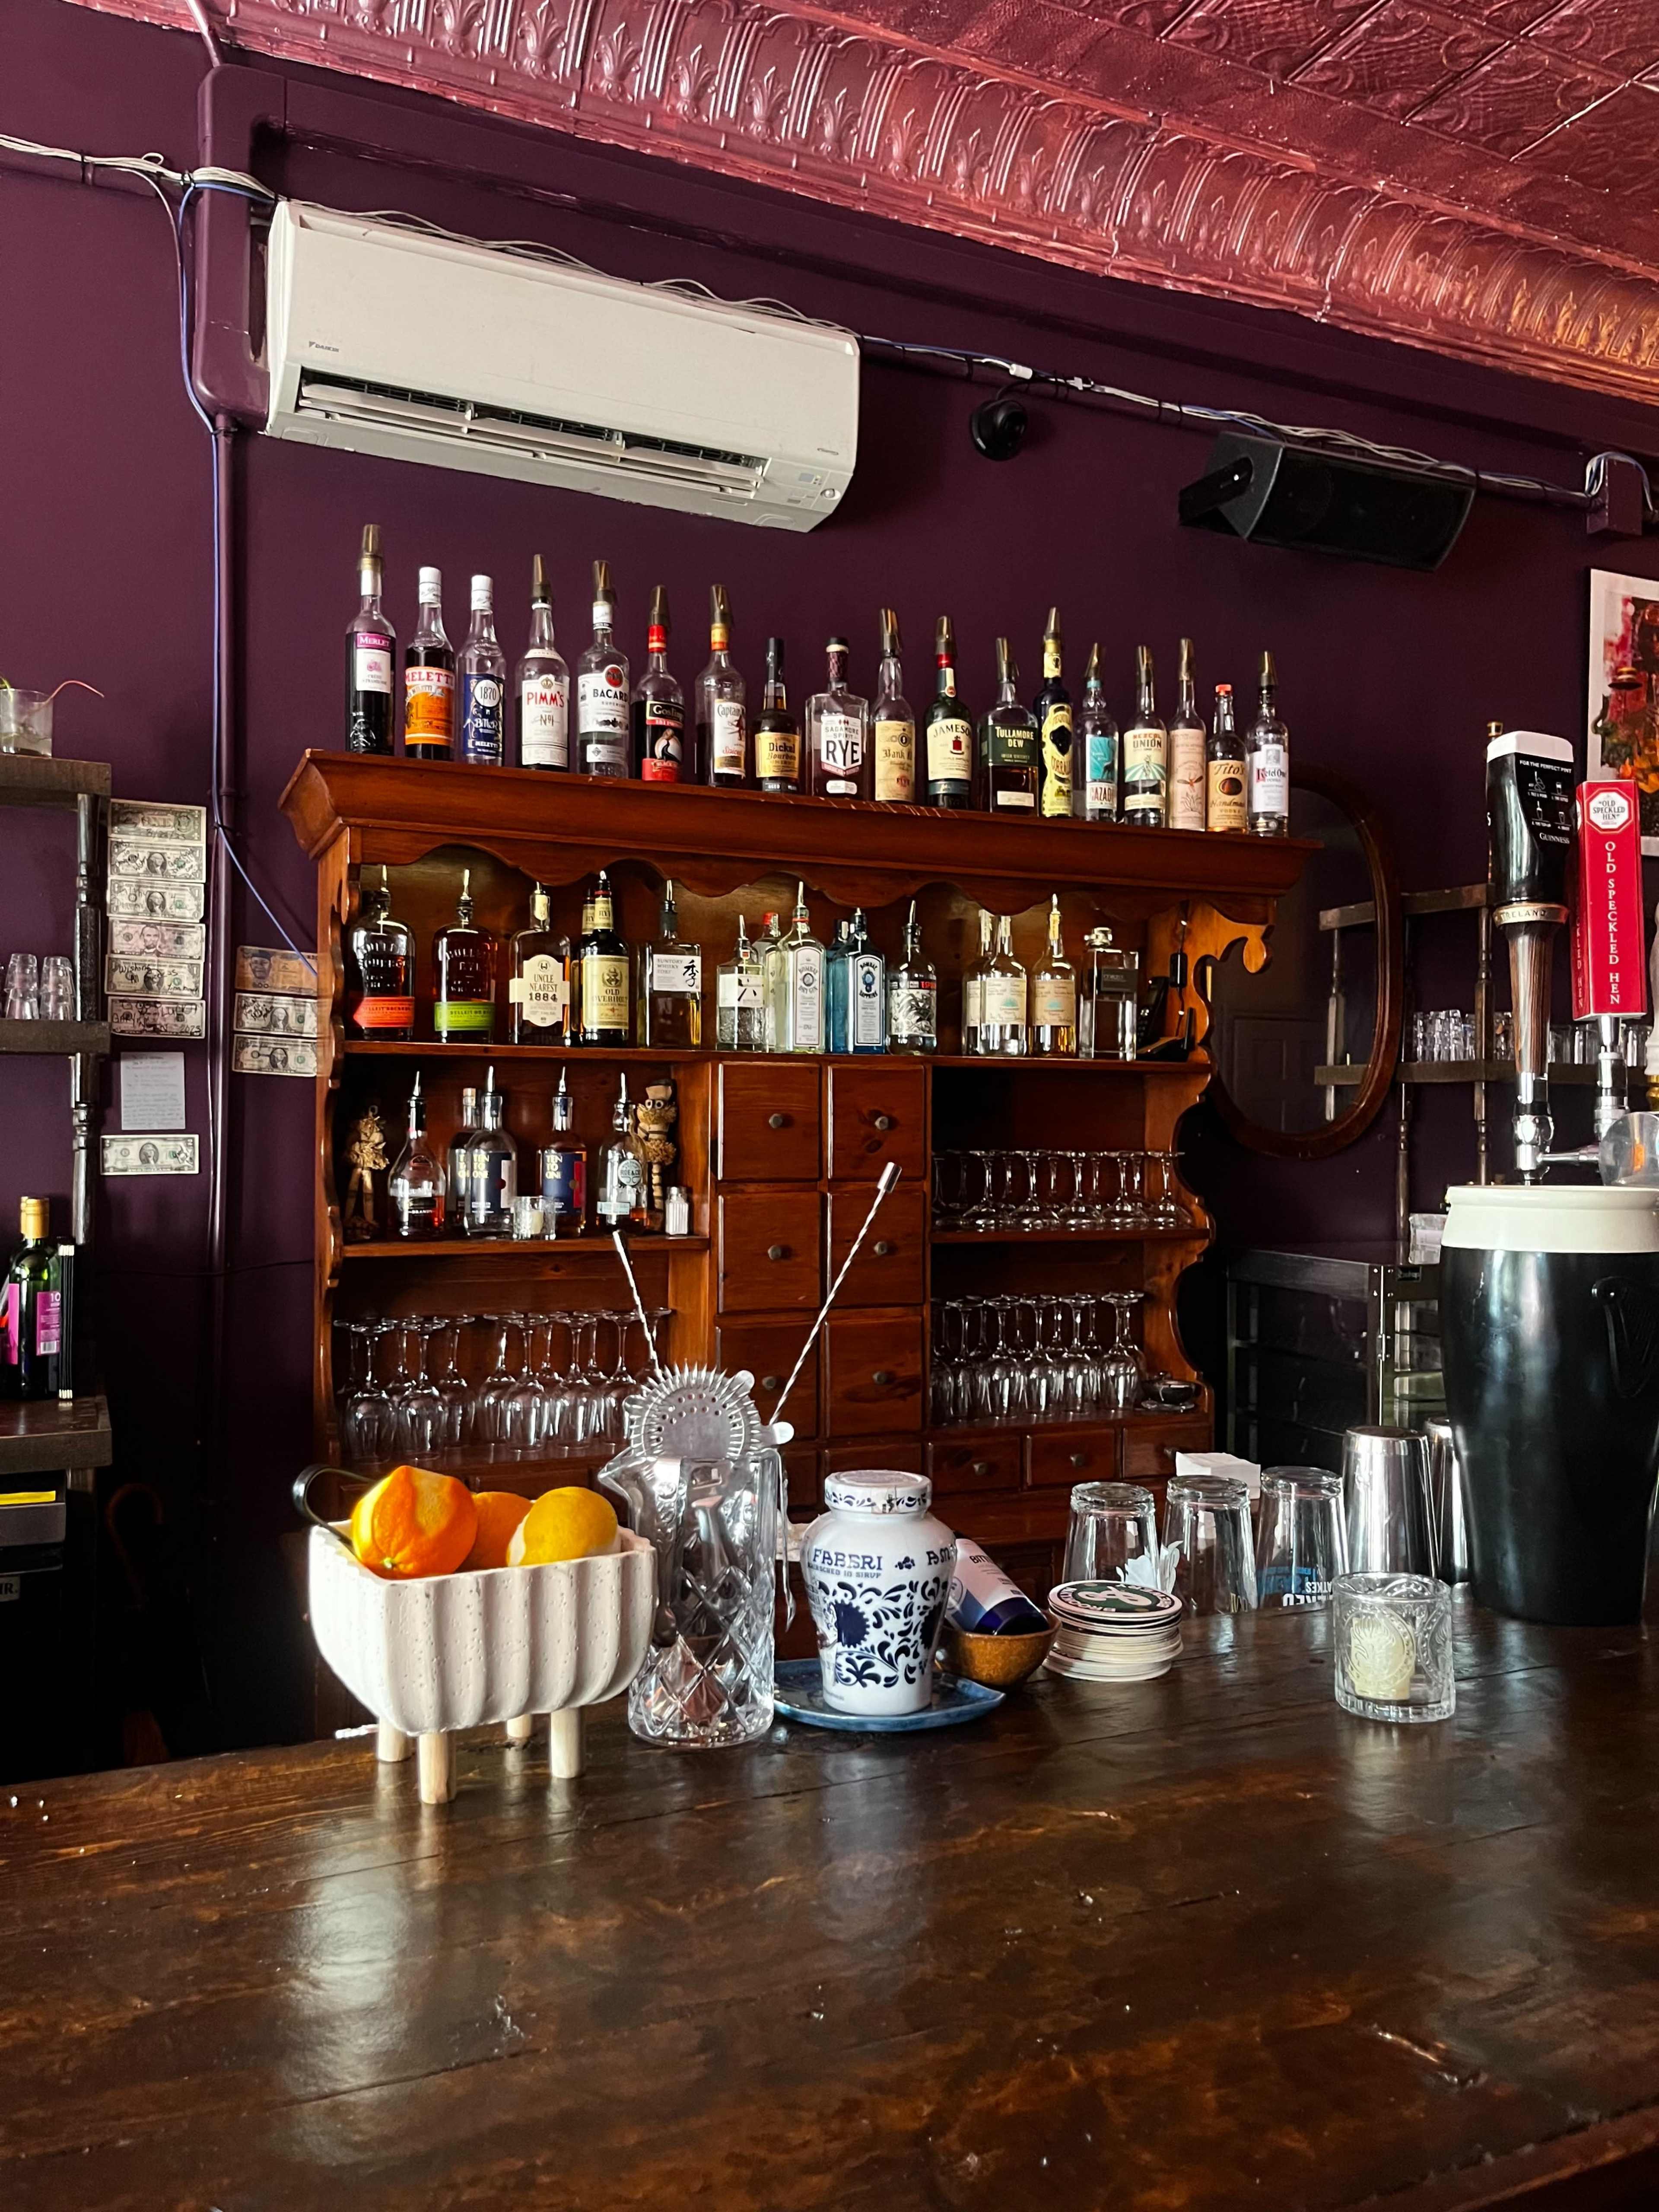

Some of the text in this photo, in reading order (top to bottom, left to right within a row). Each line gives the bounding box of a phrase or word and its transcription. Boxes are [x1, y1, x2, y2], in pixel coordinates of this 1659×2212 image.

[359, 636, 390, 647] MERLET
[480, 686, 497, 701] 1870
[526, 691, 565, 708] PIMM'S
[593, 689, 629, 702] BACARD
[717, 704, 743, 718] Captain
[825, 726, 859, 735] SAGAMORE
[933, 724, 971, 738] JAMESO
[995, 726, 1034, 740] TULLAMORE
[1008, 739, 1024, 747] DEW
[826, 740, 859, 767] RYE
[1214, 763, 1245, 776] Tito's
[1540, 763, 1560, 772] PERFECT
[1539, 832, 1570, 844] GUINNESS
[1605, 841, 1621, 1005] OLD SPECKLED HEN
[534, 974, 554, 984] UNCLE
[529, 983, 558, 993] NEAREST
[529, 993, 558, 1003] 1884
[592, 995, 628, 1004] VERHO
[545, 1154, 563, 1163] TEN
[546, 1163, 559, 1172] TO
[813, 1548, 883, 1571] FABBRI
[1305, 1581, 1333, 1594] ATKES
